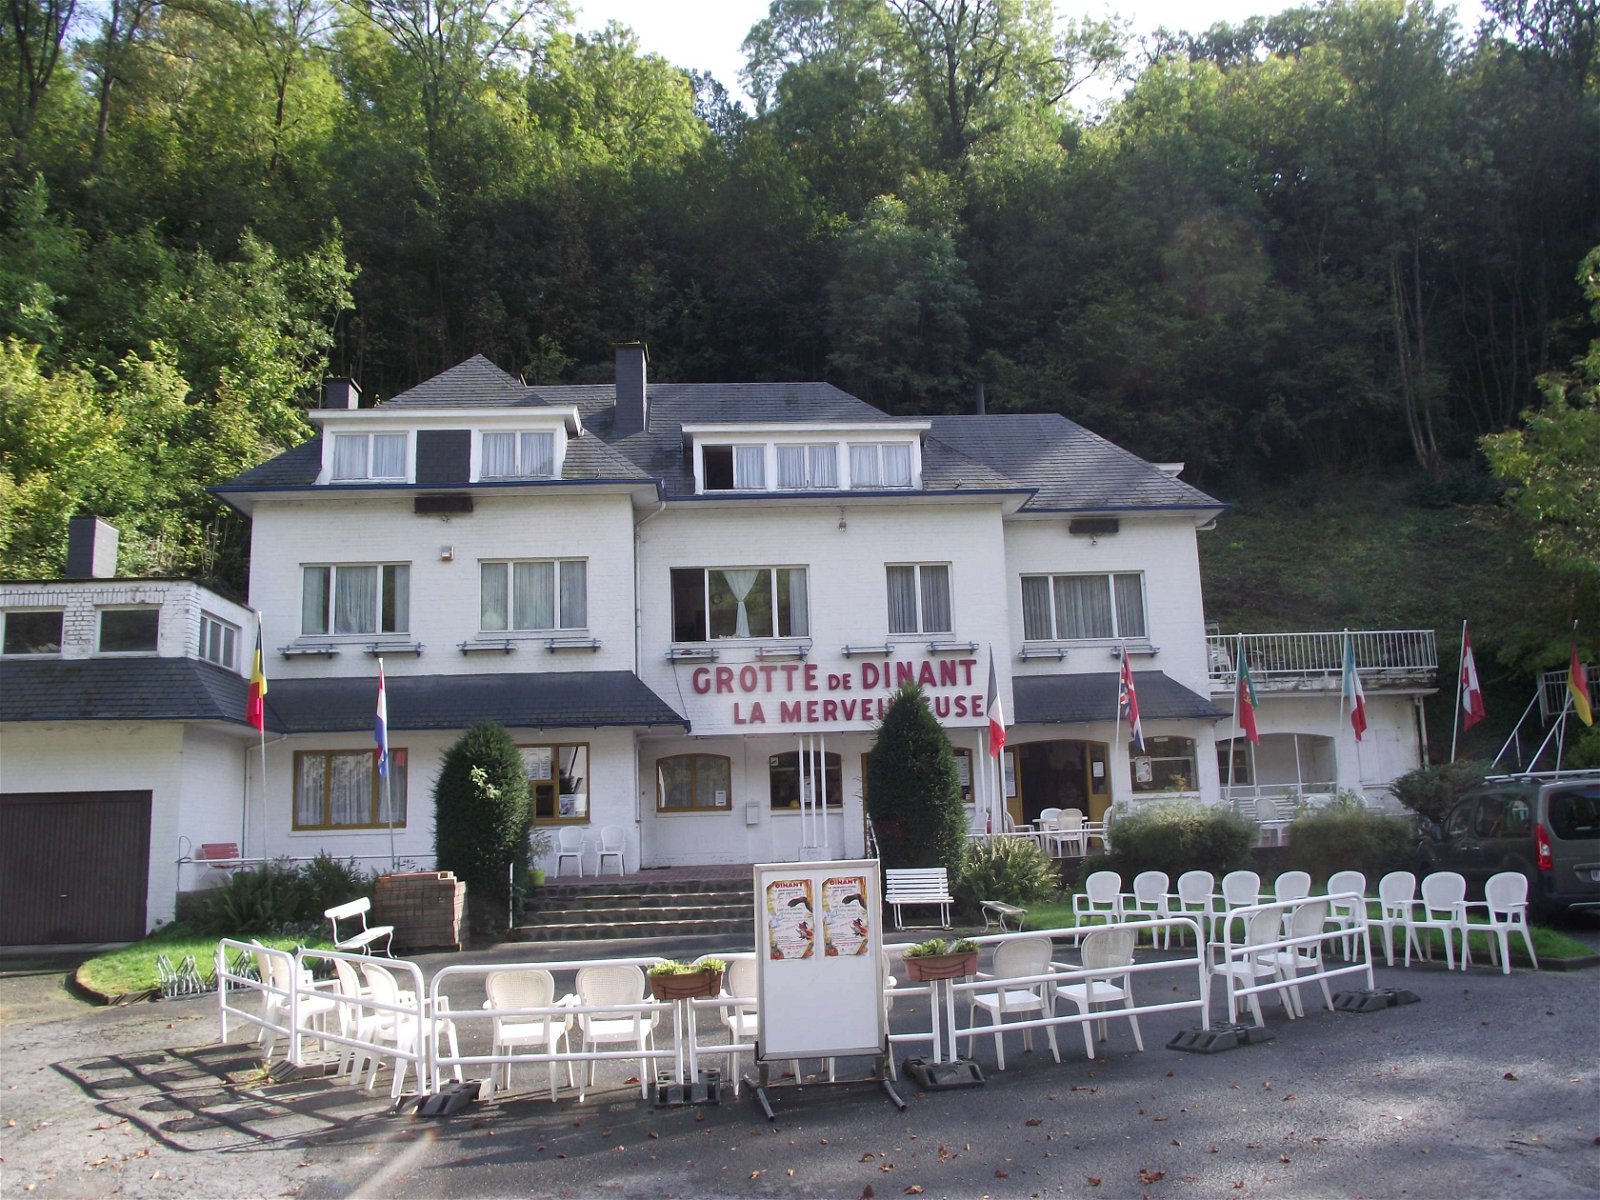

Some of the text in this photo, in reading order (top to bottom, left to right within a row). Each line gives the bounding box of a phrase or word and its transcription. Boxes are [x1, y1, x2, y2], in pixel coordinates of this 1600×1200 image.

[693, 659, 977, 693] GROTTE DE DINANT
[733, 695, 984, 724] LA MERVEIUSE
